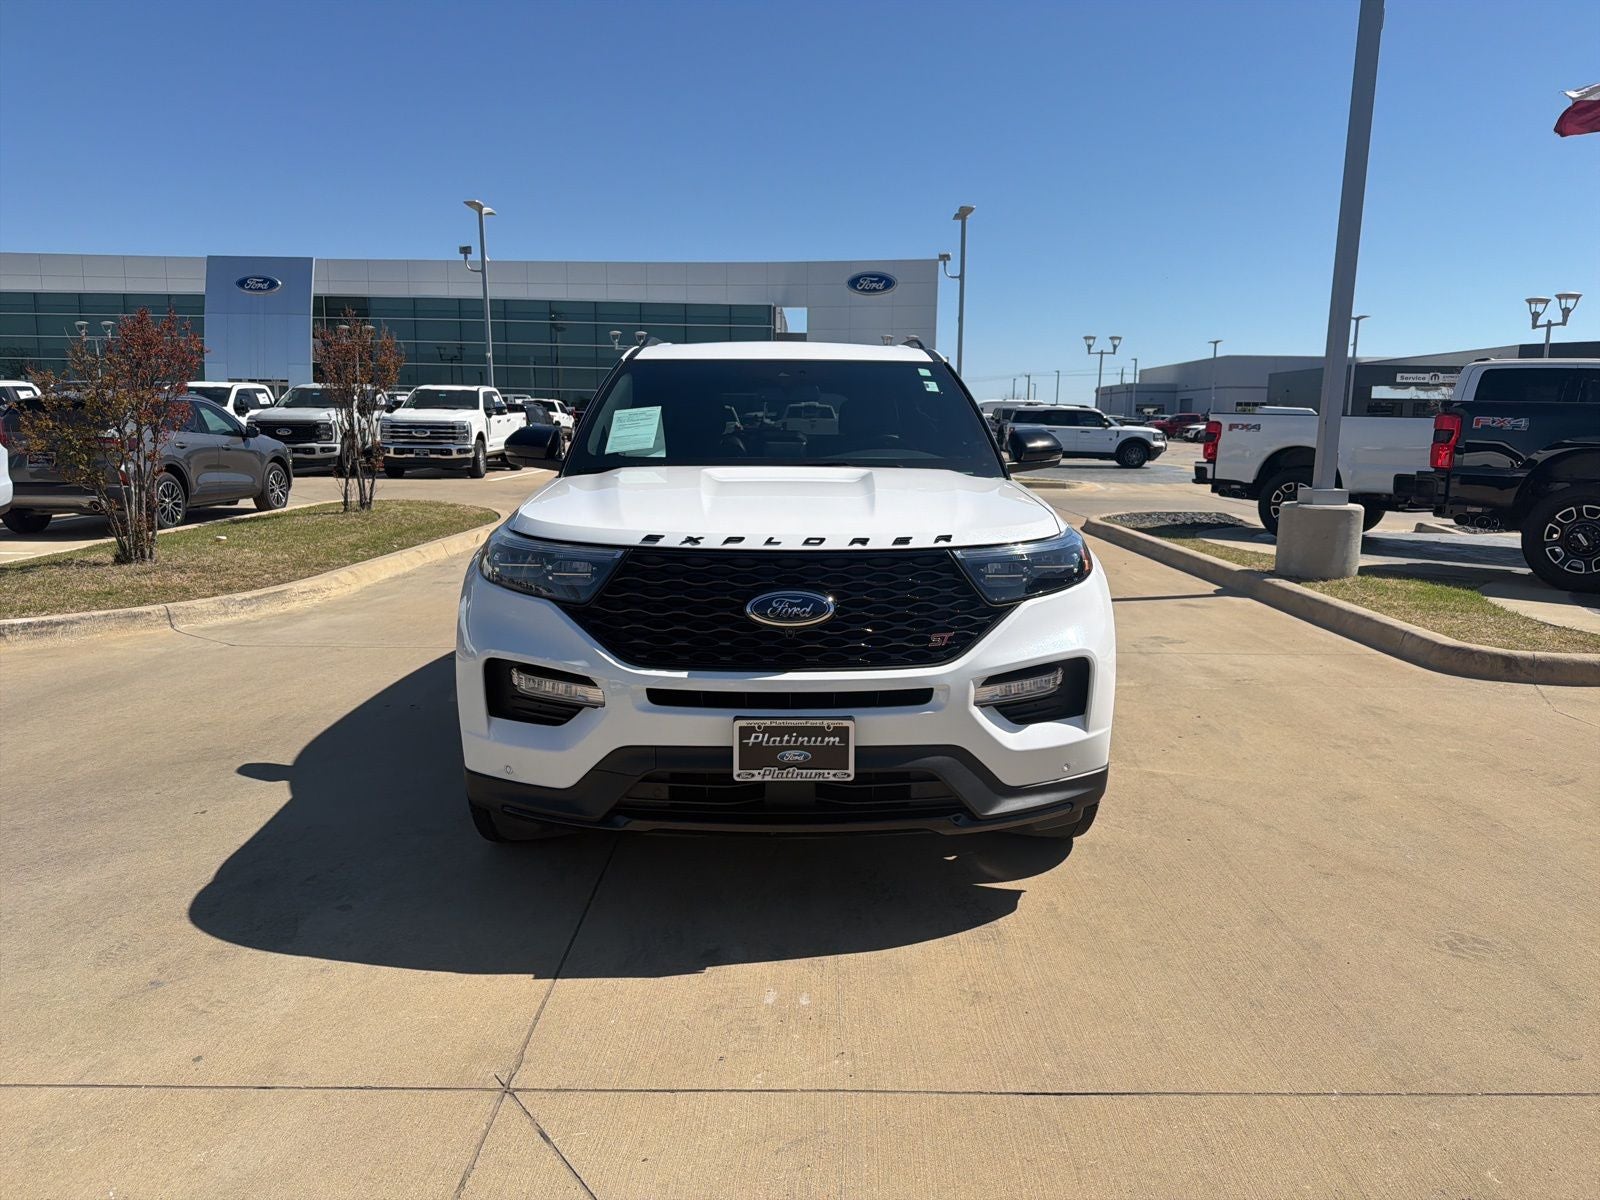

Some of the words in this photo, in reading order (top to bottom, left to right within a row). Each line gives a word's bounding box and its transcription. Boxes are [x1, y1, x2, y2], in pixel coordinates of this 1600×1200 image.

[244, 278, 270, 290] Ford
[857, 276, 886, 290] Ford
[1228, 423, 1262, 432] FX4
[1472, 416, 1530, 431] FX4
[640, 534, 953, 547] EXPLORER
[767, 597, 814, 618] Ford
[928, 631, 955, 647] ST
[742, 732, 846, 747] Platinum
[783, 752, 805, 761] Ford
[761, 767, 831, 780] Platinum
